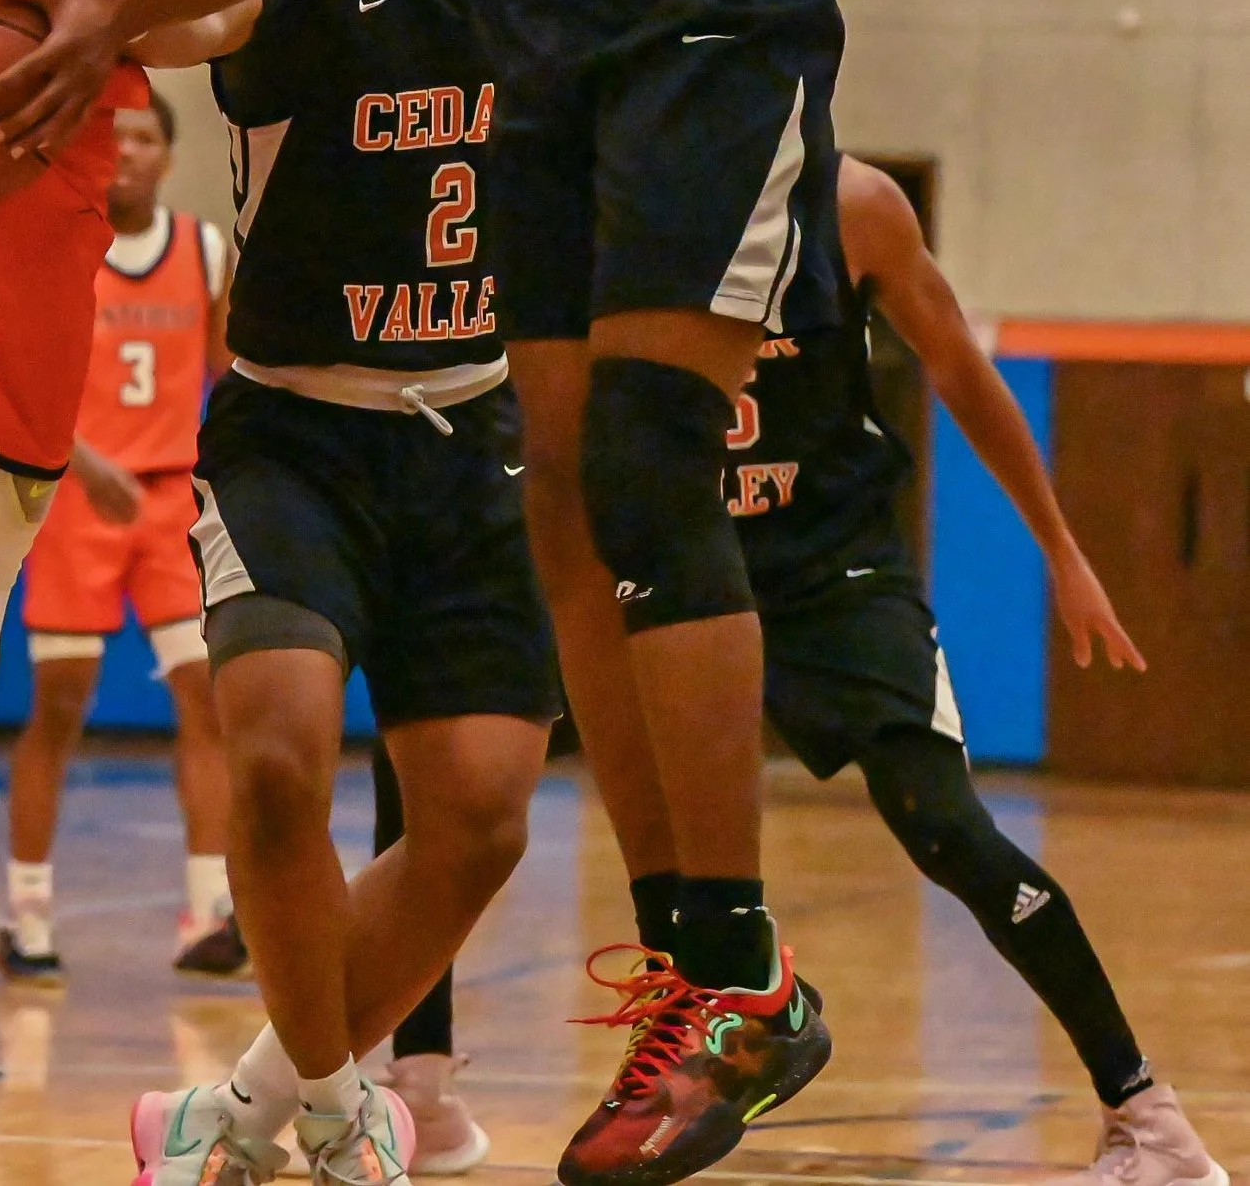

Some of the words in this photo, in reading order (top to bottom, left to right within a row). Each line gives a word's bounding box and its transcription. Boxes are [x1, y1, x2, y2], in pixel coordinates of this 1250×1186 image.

[352, 83, 495, 152] CEDA
[426, 161, 478, 268] 2
[343, 276, 496, 342] VALLE
[118, 341, 155, 406] 3
